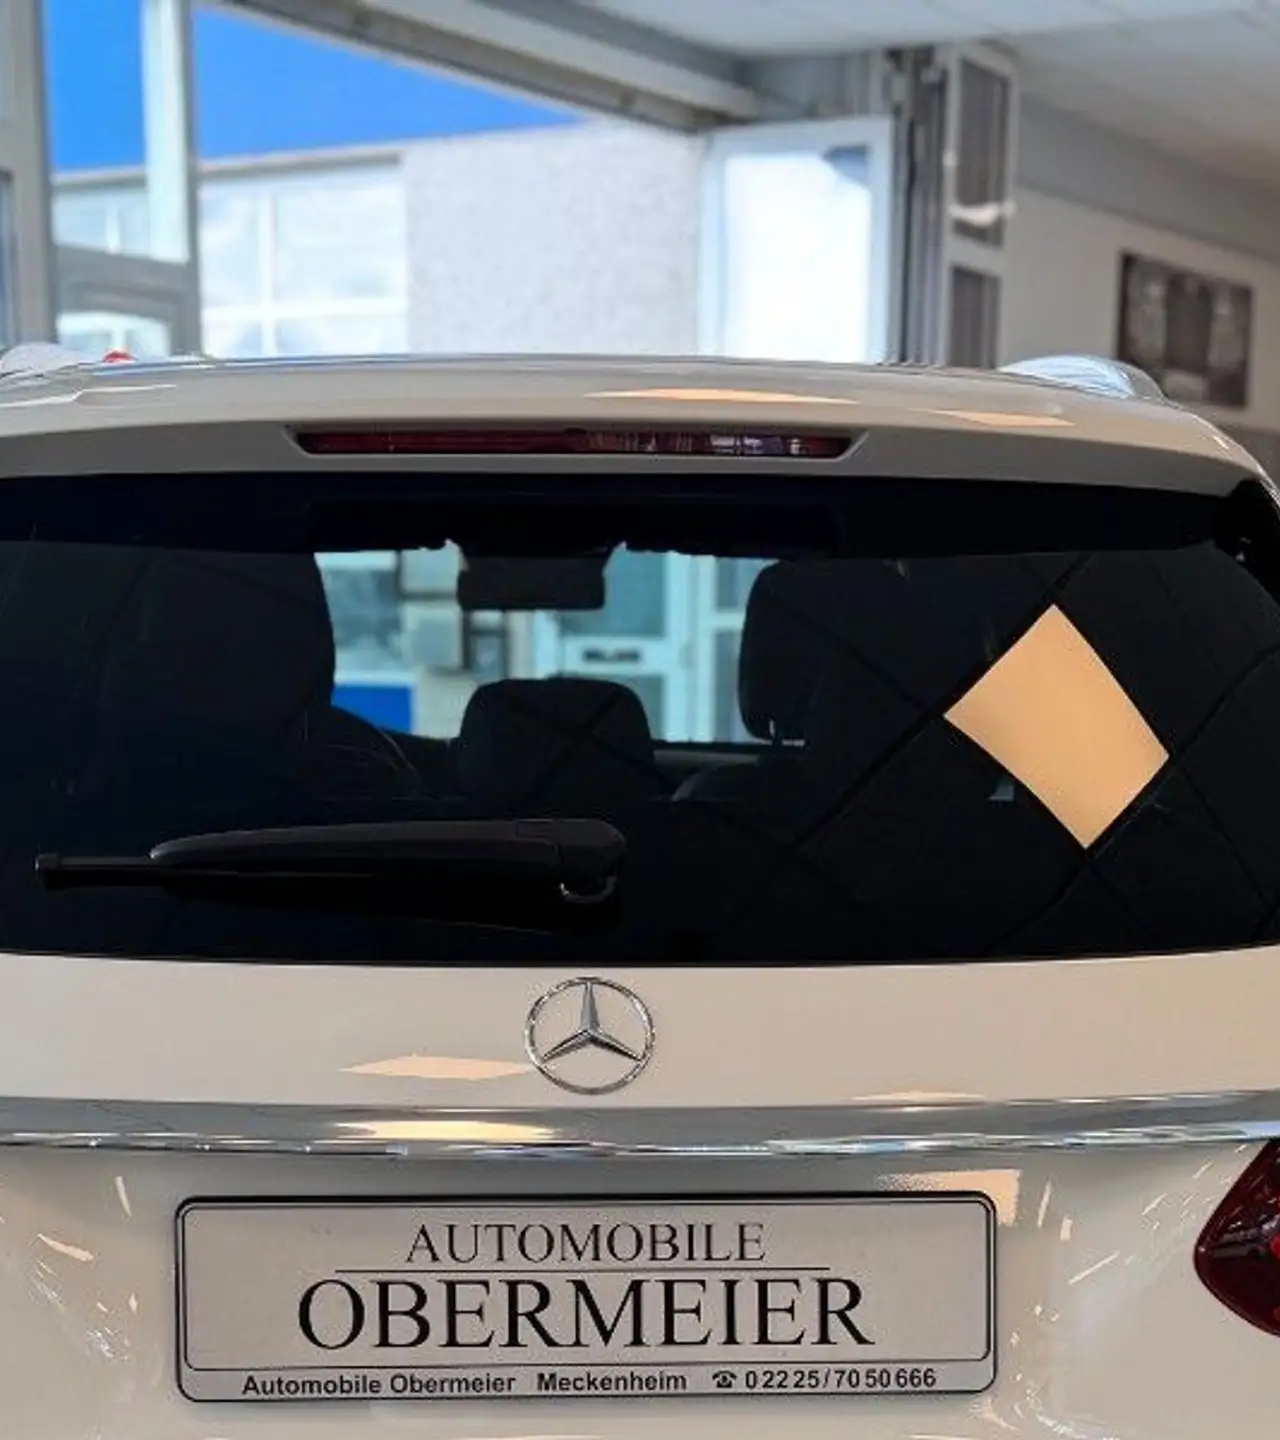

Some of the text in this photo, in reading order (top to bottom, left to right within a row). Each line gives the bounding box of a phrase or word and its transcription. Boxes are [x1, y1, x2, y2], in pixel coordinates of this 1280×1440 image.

[405, 1222, 767, 1264] AUTOMOBILE
[297, 1277, 877, 1352] OBERMEIER
[241, 1373, 382, 1396] Automobile
[390, 1371, 517, 1395] Obermeier
[537, 1370, 687, 1393] Meckenheim
